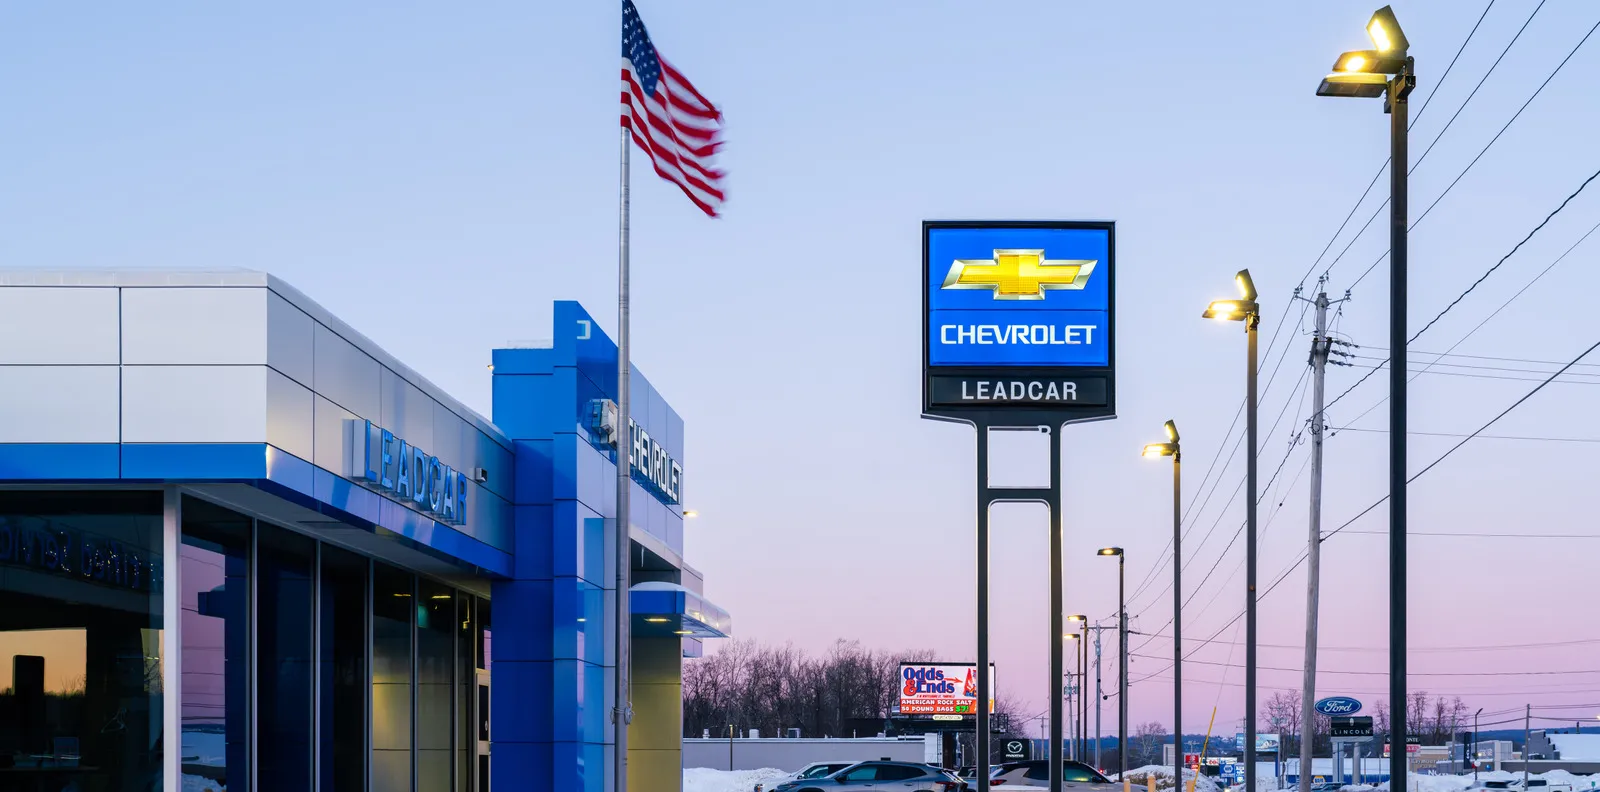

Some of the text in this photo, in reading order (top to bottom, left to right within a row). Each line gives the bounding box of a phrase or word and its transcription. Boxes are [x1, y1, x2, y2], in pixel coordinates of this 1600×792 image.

[941, 324, 1097, 345] CHEVROLET
[961, 380, 1077, 401] LEADCAR
[363, 419, 468, 526] LEADCAR
[903, 667, 944, 681] Odds
[903, 679, 955, 696] & Ends
[1324, 700, 1353, 712] Ford
